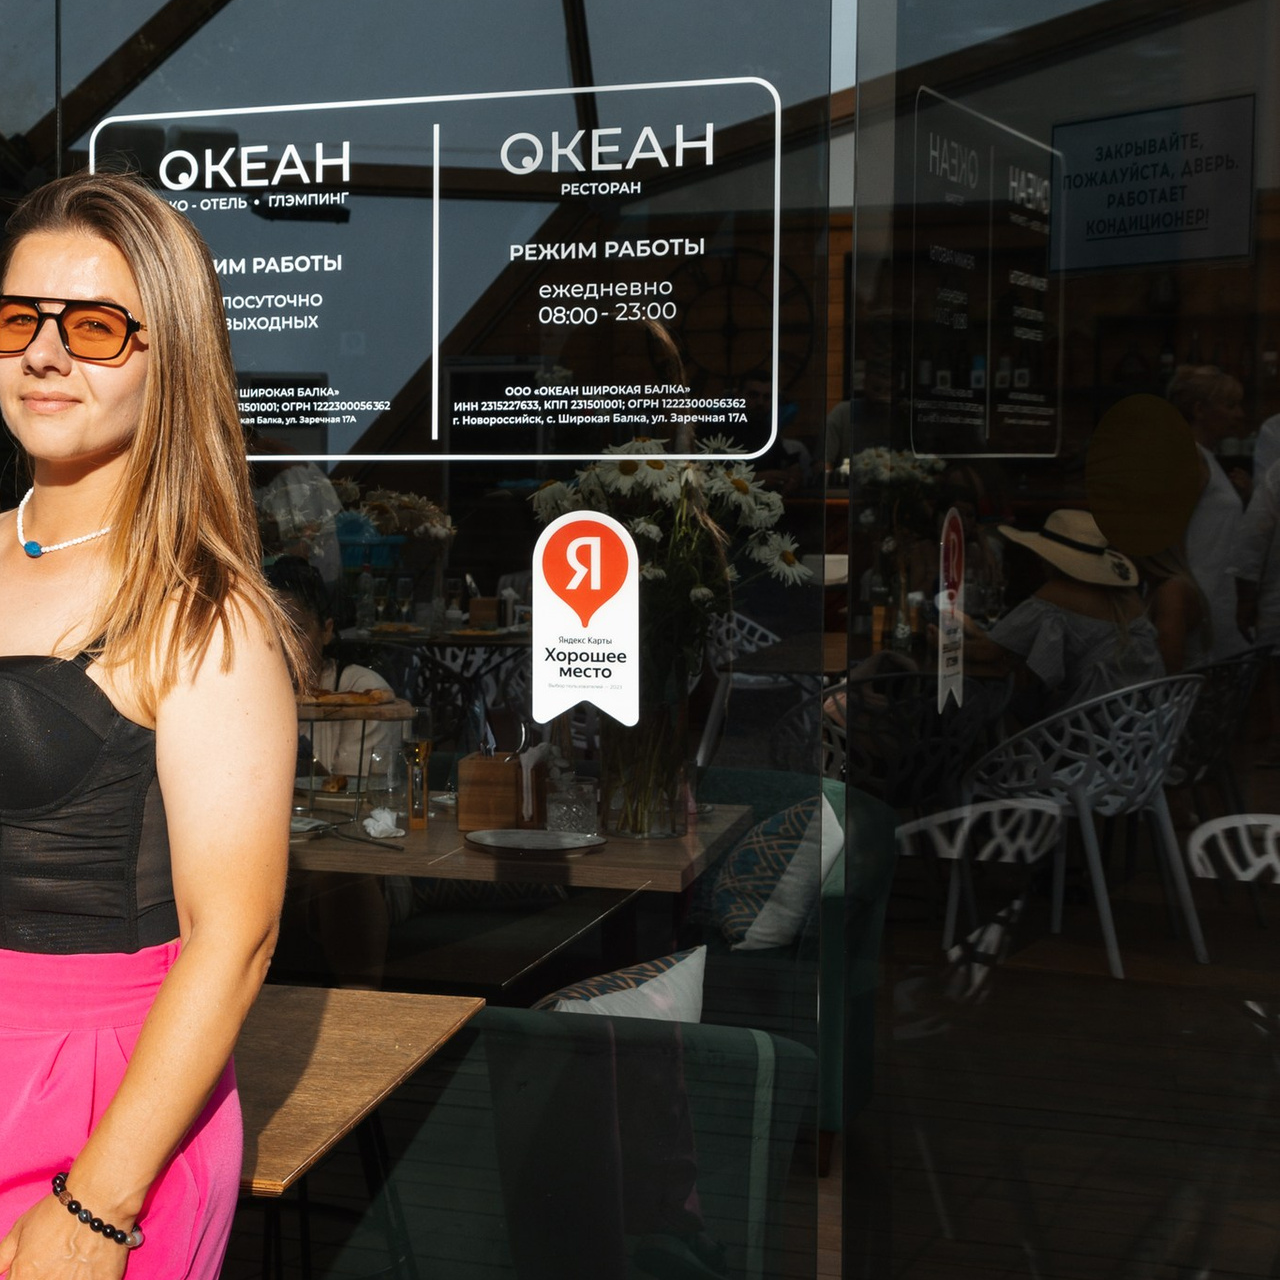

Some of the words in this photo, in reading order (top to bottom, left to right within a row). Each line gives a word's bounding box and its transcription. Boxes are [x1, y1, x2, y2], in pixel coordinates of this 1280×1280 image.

[501, 123, 714, 175] ОКЕАН
[1095, 132, 1204, 162] ЗАКРЫВАЙТЕ,
[158, 141, 350, 191] ОКЕАН
[1063, 162, 1175, 190] ПОЖАЛУЙСТА,
[561, 182, 641, 195] РЕСТОРАН
[1107, 185, 1188, 209] РАБОТАЕТ
[200, 196, 247, 211] ОТЕЛЬ
[269, 192, 349, 208] ГЛЭМПИНГ
[1086, 208, 1209, 236] КОНДИЦИОНЕР!
[508, 241, 596, 261] РЕЖИМ
[605, 238, 704, 258] РАБОТЫ
[252, 254, 342, 274] РАБОТЫ
[539, 281, 672, 300] ежедневно
[223, 294, 323, 309] ЛОСУТОЧНО
[539, 306, 597, 324] 08:00
[616, 302, 676, 322] 23:00
[239, 388, 295, 399] ШИРОКАЯ
[297, 387, 340, 397] БАЛКА»
[505, 387, 531, 396] ООО
[534, 386, 578, 396] «ОКЕАН
[582, 385, 641, 395] ШИРОКАЯ
[645, 385, 690, 394] БАЛКА»
[281, 402, 311, 412] ОГРН
[313, 401, 391, 411] 1222300056362
[454, 402, 478, 411] ИНН
[481, 400, 541, 411] 2315227633,
[544, 400, 568, 409] КПП
[571, 399, 625, 410] 231501001;
[628, 399, 659, 408] ОГРН
[662, 399, 746, 408] 1222300056362
[257, 416, 284, 425] Балка,
[299, 416, 340, 425] Заречная
[463, 414, 544, 426] Новороссийск,
[559, 414, 610, 425] Широкая
[613, 413, 649, 424] Балка,
[652, 415, 667, 424] ул.
[670, 413, 725, 424] Заречная
[565, 536, 601, 590] Я
[558, 636, 586, 645] Яндекс
[588, 637, 612, 645] Карты
[544, 647, 627, 665] Хорошее
[559, 666, 612, 678] место
